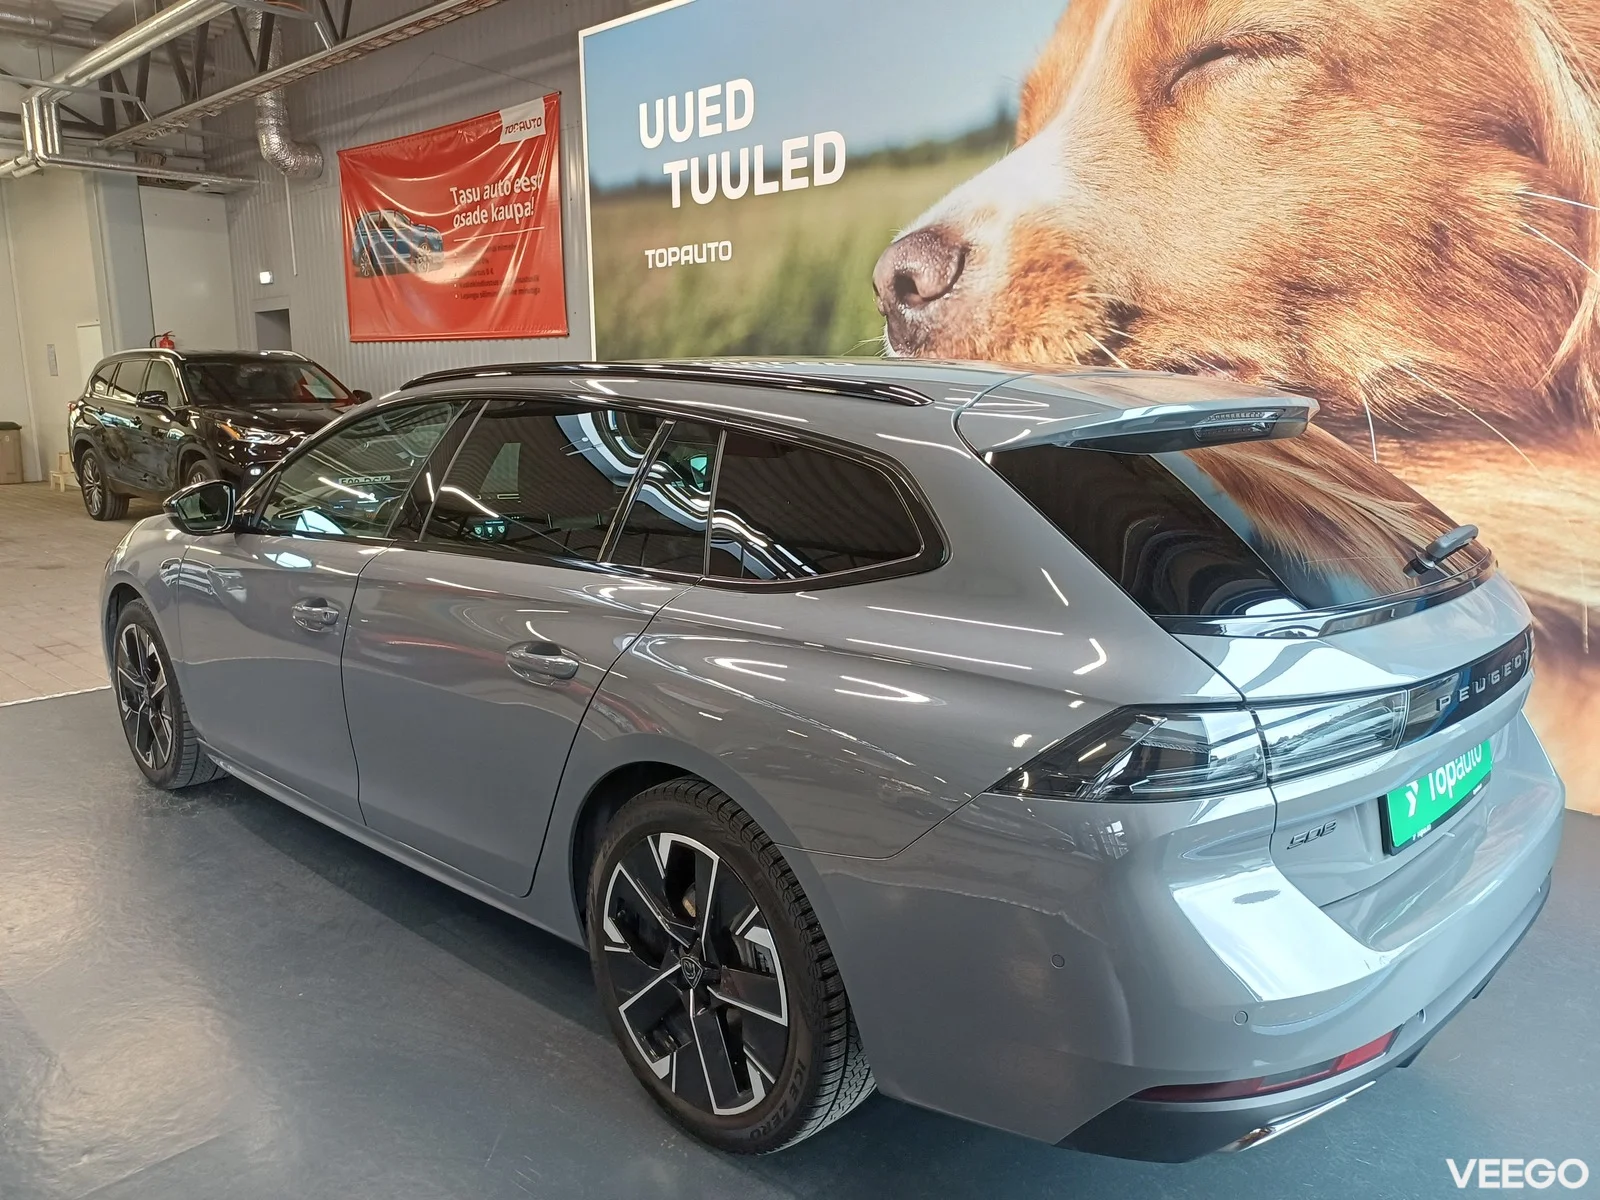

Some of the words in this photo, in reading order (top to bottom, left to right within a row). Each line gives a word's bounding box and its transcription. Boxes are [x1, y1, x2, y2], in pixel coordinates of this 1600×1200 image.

[639, 78, 755, 149] UUED
[663, 130, 846, 209] TUULED
[450, 186, 481, 206] Tasu
[483, 178, 512, 201] auto
[453, 204, 489, 229] osade
[491, 196, 535, 225] kaupa!
[644, 240, 732, 269] TOPAUTO
